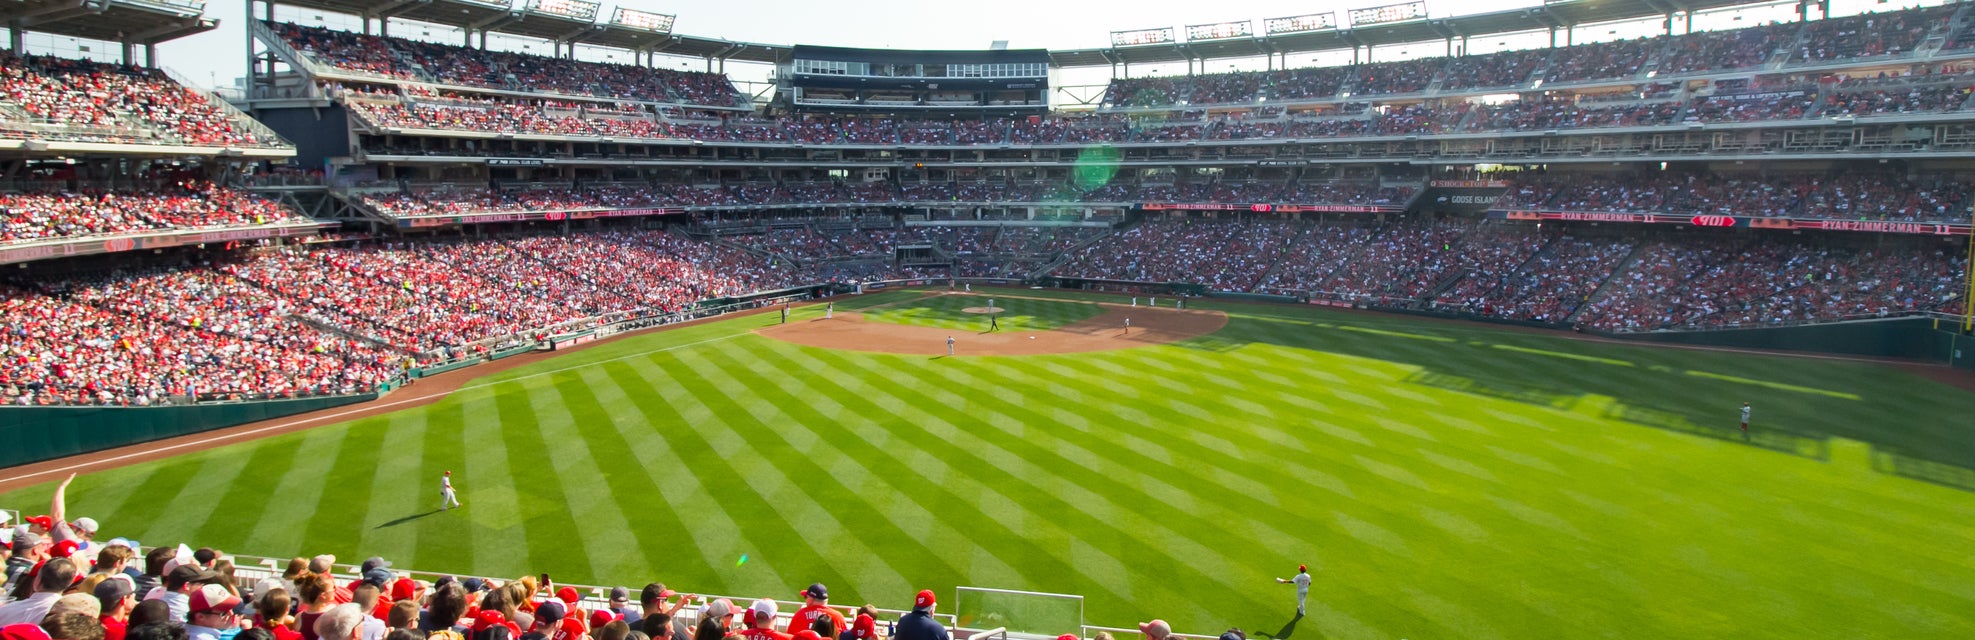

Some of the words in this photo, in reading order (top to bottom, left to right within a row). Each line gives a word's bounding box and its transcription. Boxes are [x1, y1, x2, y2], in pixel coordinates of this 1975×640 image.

[1439, 180, 1464, 188] SHOCK
[1451, 195, 1473, 204] GOOSE
[1329, 205, 1364, 213] ZIMMERMAN
[1560, 211, 1581, 221] RYAN
[1583, 212, 1634, 222] ZIMMERMAN
[1643, 214, 1656, 223] 11
[1822, 220, 1849, 231] RYAN
[1852, 222, 1921, 234] ZIMMERMAN
[1934, 224, 1951, 235] 11
